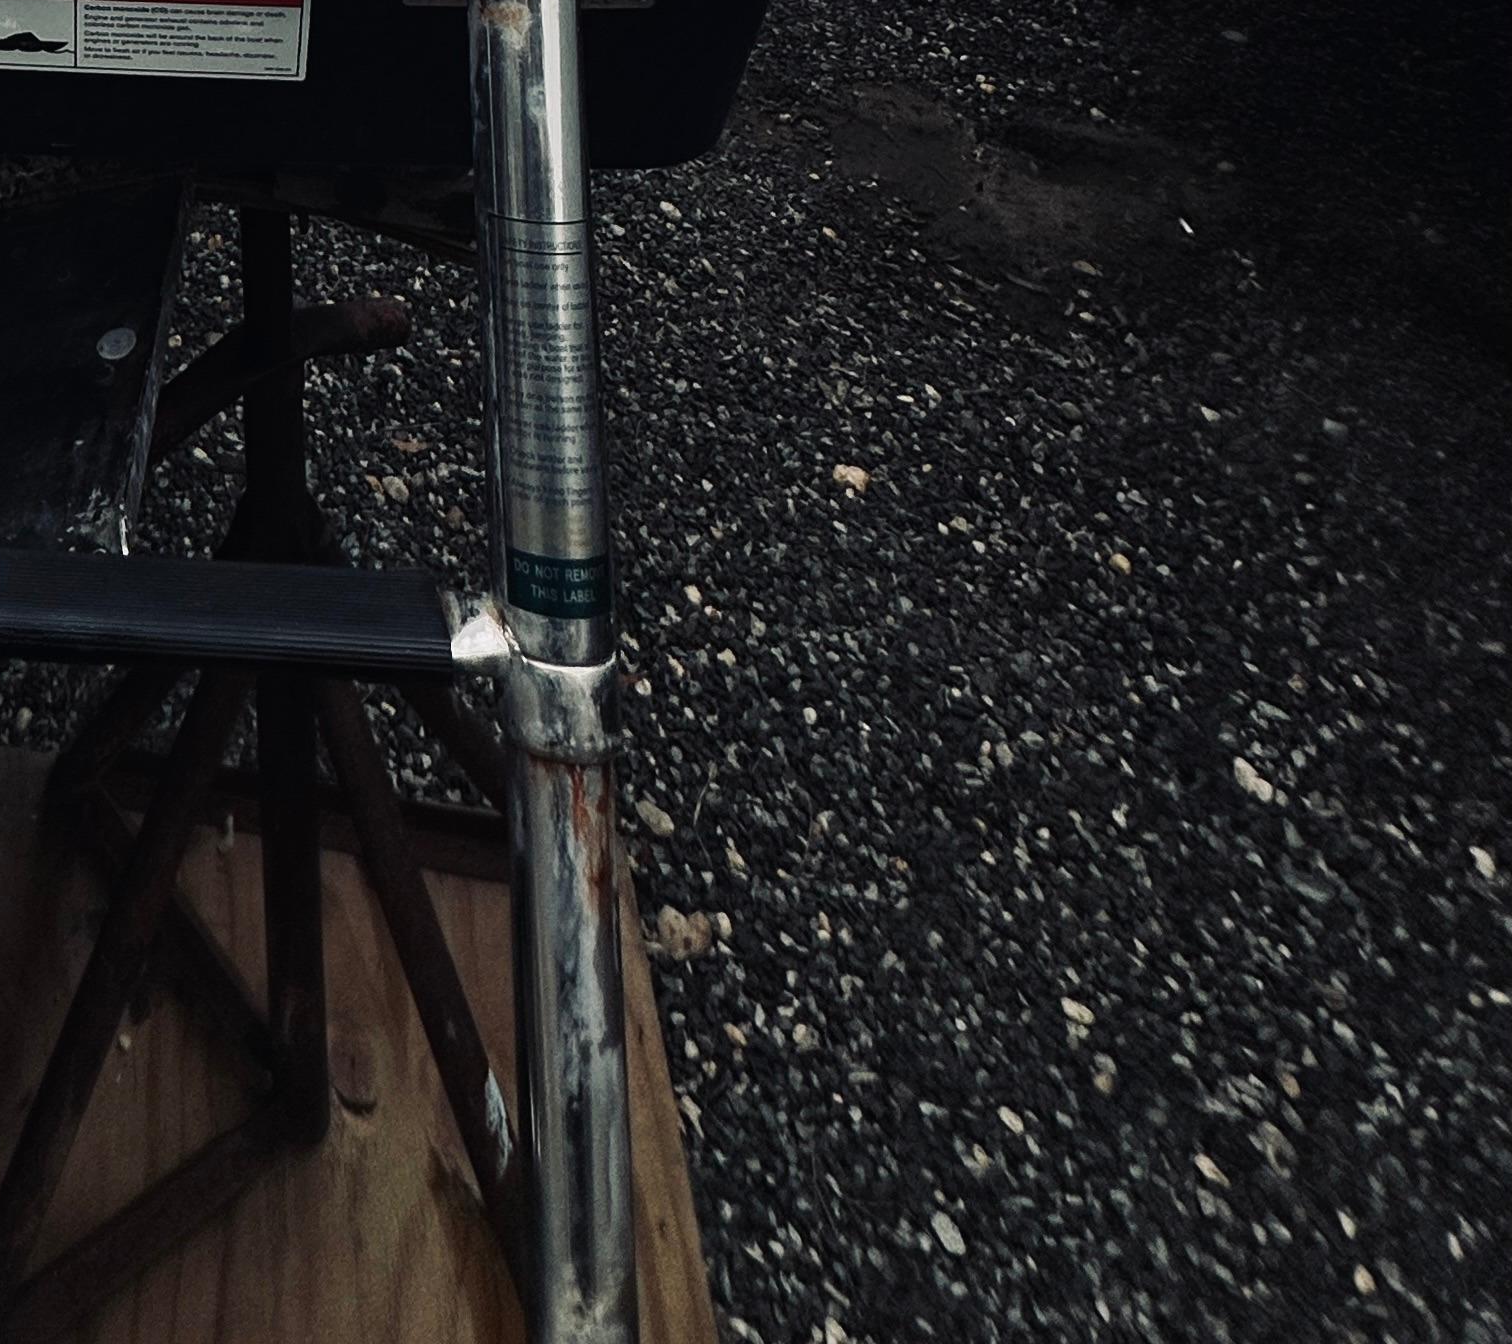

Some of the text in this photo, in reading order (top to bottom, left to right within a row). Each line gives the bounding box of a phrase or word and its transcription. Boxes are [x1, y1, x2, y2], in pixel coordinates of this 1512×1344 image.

[514, 559, 530, 574] DO
[535, 564, 560, 580] NOT
[530, 584, 596, 603] THIS LABEL
